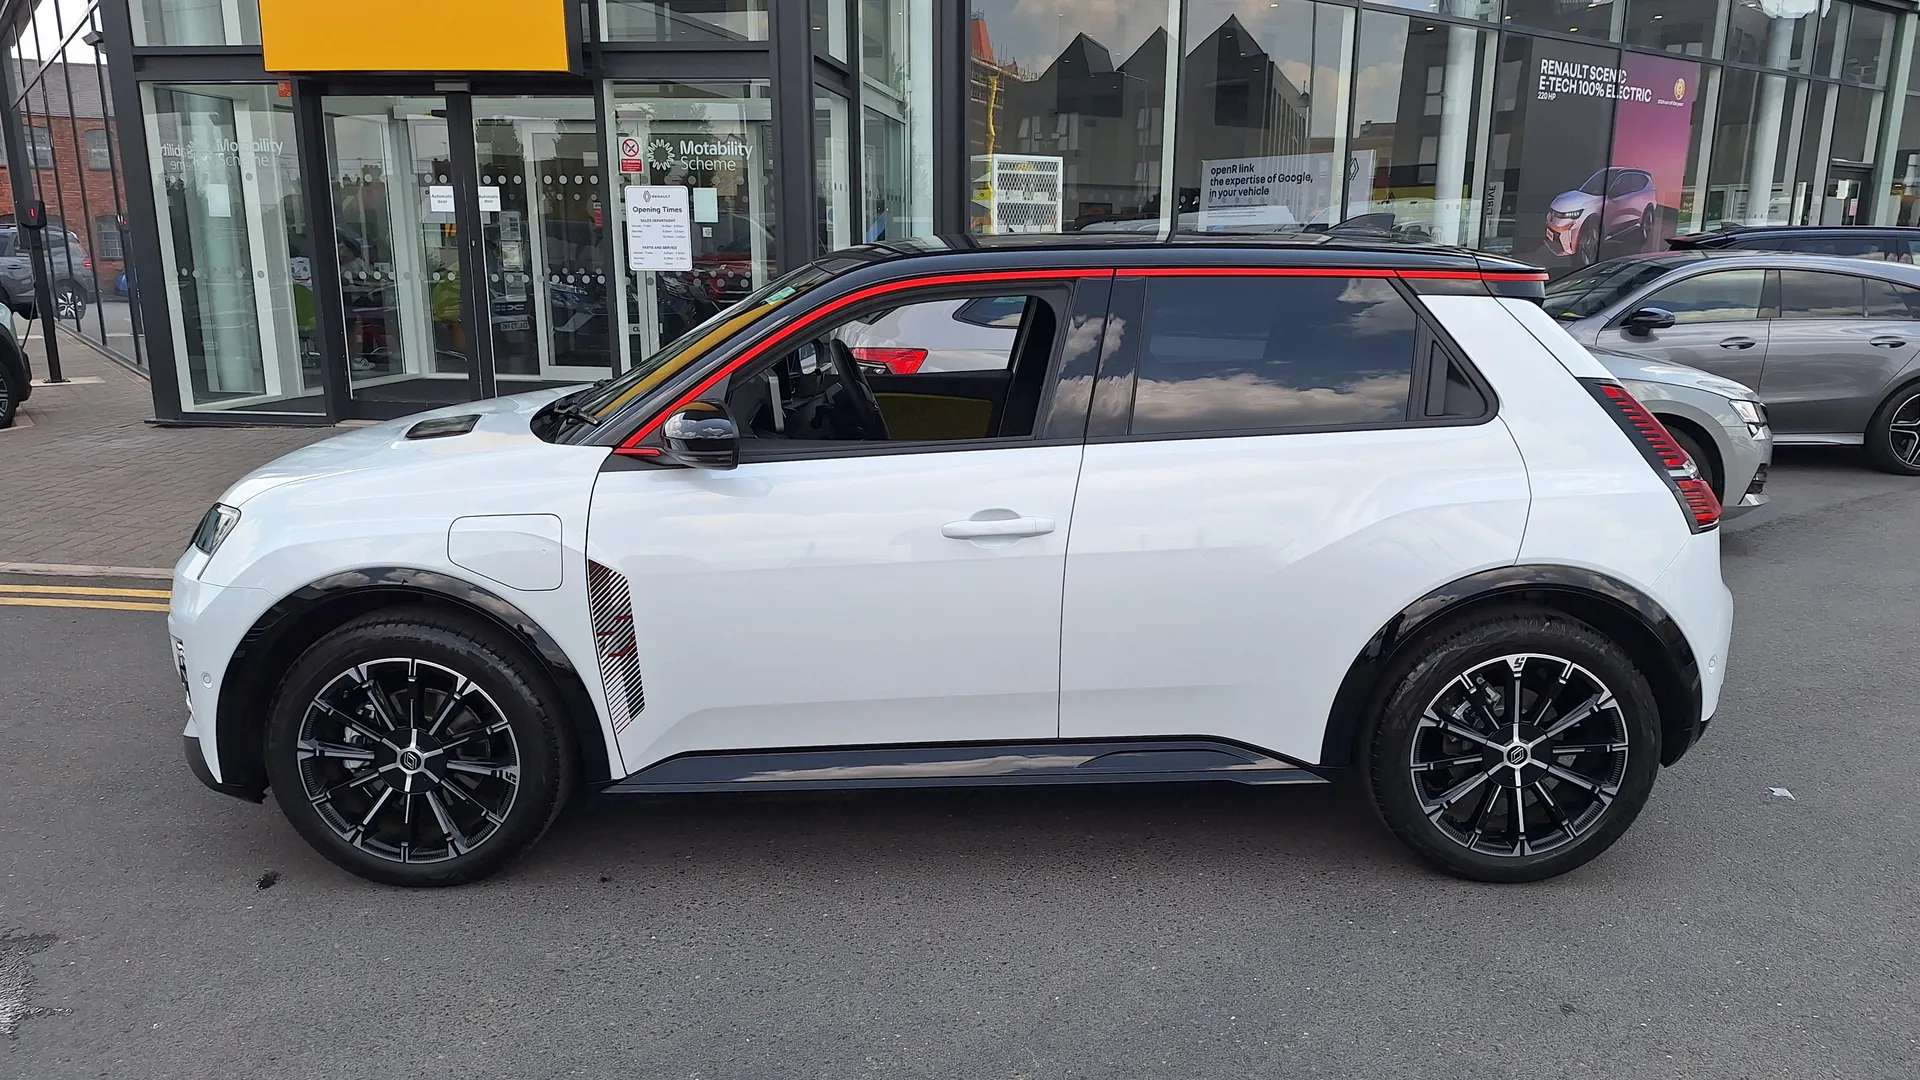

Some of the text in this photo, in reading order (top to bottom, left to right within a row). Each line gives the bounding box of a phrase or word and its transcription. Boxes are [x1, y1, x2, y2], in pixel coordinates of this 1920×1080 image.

[1540, 59, 1627, 84] RENAULT SCENIC
[1538, 76, 1652, 102] E-TECH 100% ELECTRIC
[1538, 92, 1548, 100] 220
[680, 140, 753, 160] Motability
[680, 156, 736, 171] Scheme
[1210, 163, 1255, 176] openR link
[1210, 172, 1313, 186] the expertise of Google,
[1209, 186, 1269, 199] in your vehicle
[632, 206, 661, 215] Opening
